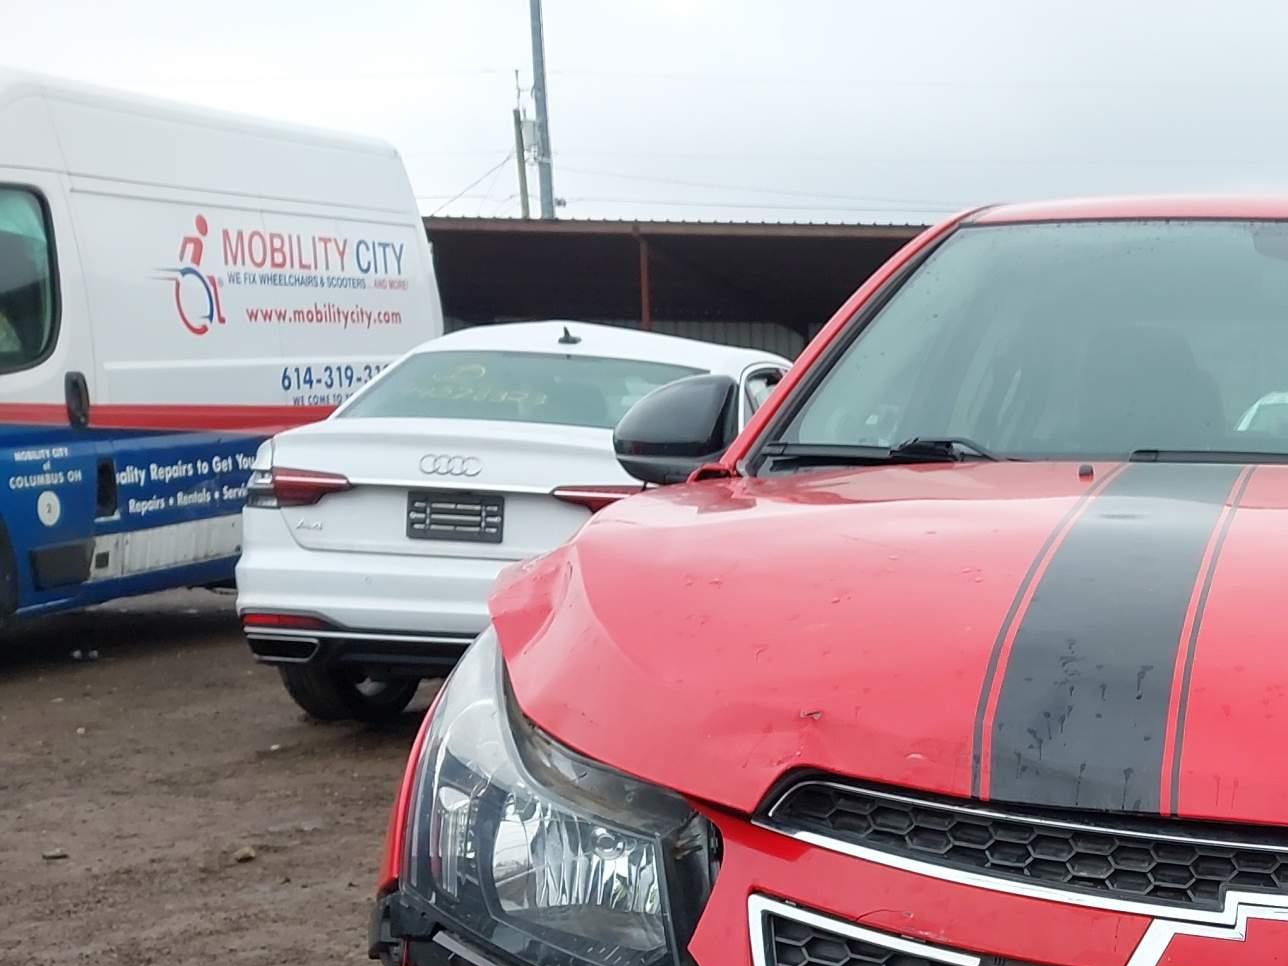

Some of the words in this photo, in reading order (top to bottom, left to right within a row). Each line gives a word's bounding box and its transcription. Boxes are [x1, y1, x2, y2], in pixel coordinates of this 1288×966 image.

[222, 228, 347, 272] MOBILITY
[356, 239, 404, 275] CITY
[227, 272, 241, 285] WE
[243, 272, 257, 285] FIX
[259, 273, 318, 287] WHEELCHAIRS
[246, 302, 402, 330] www.mobilitycity.com
[9, 473, 64, 490] COLUMBUS
[150, 459, 194, 483] Repairs
[197, 459, 209, 474] to
[212, 455, 233, 473] Get
[128, 495, 166, 516] Repairs
[177, 487, 212, 507] Rentals
